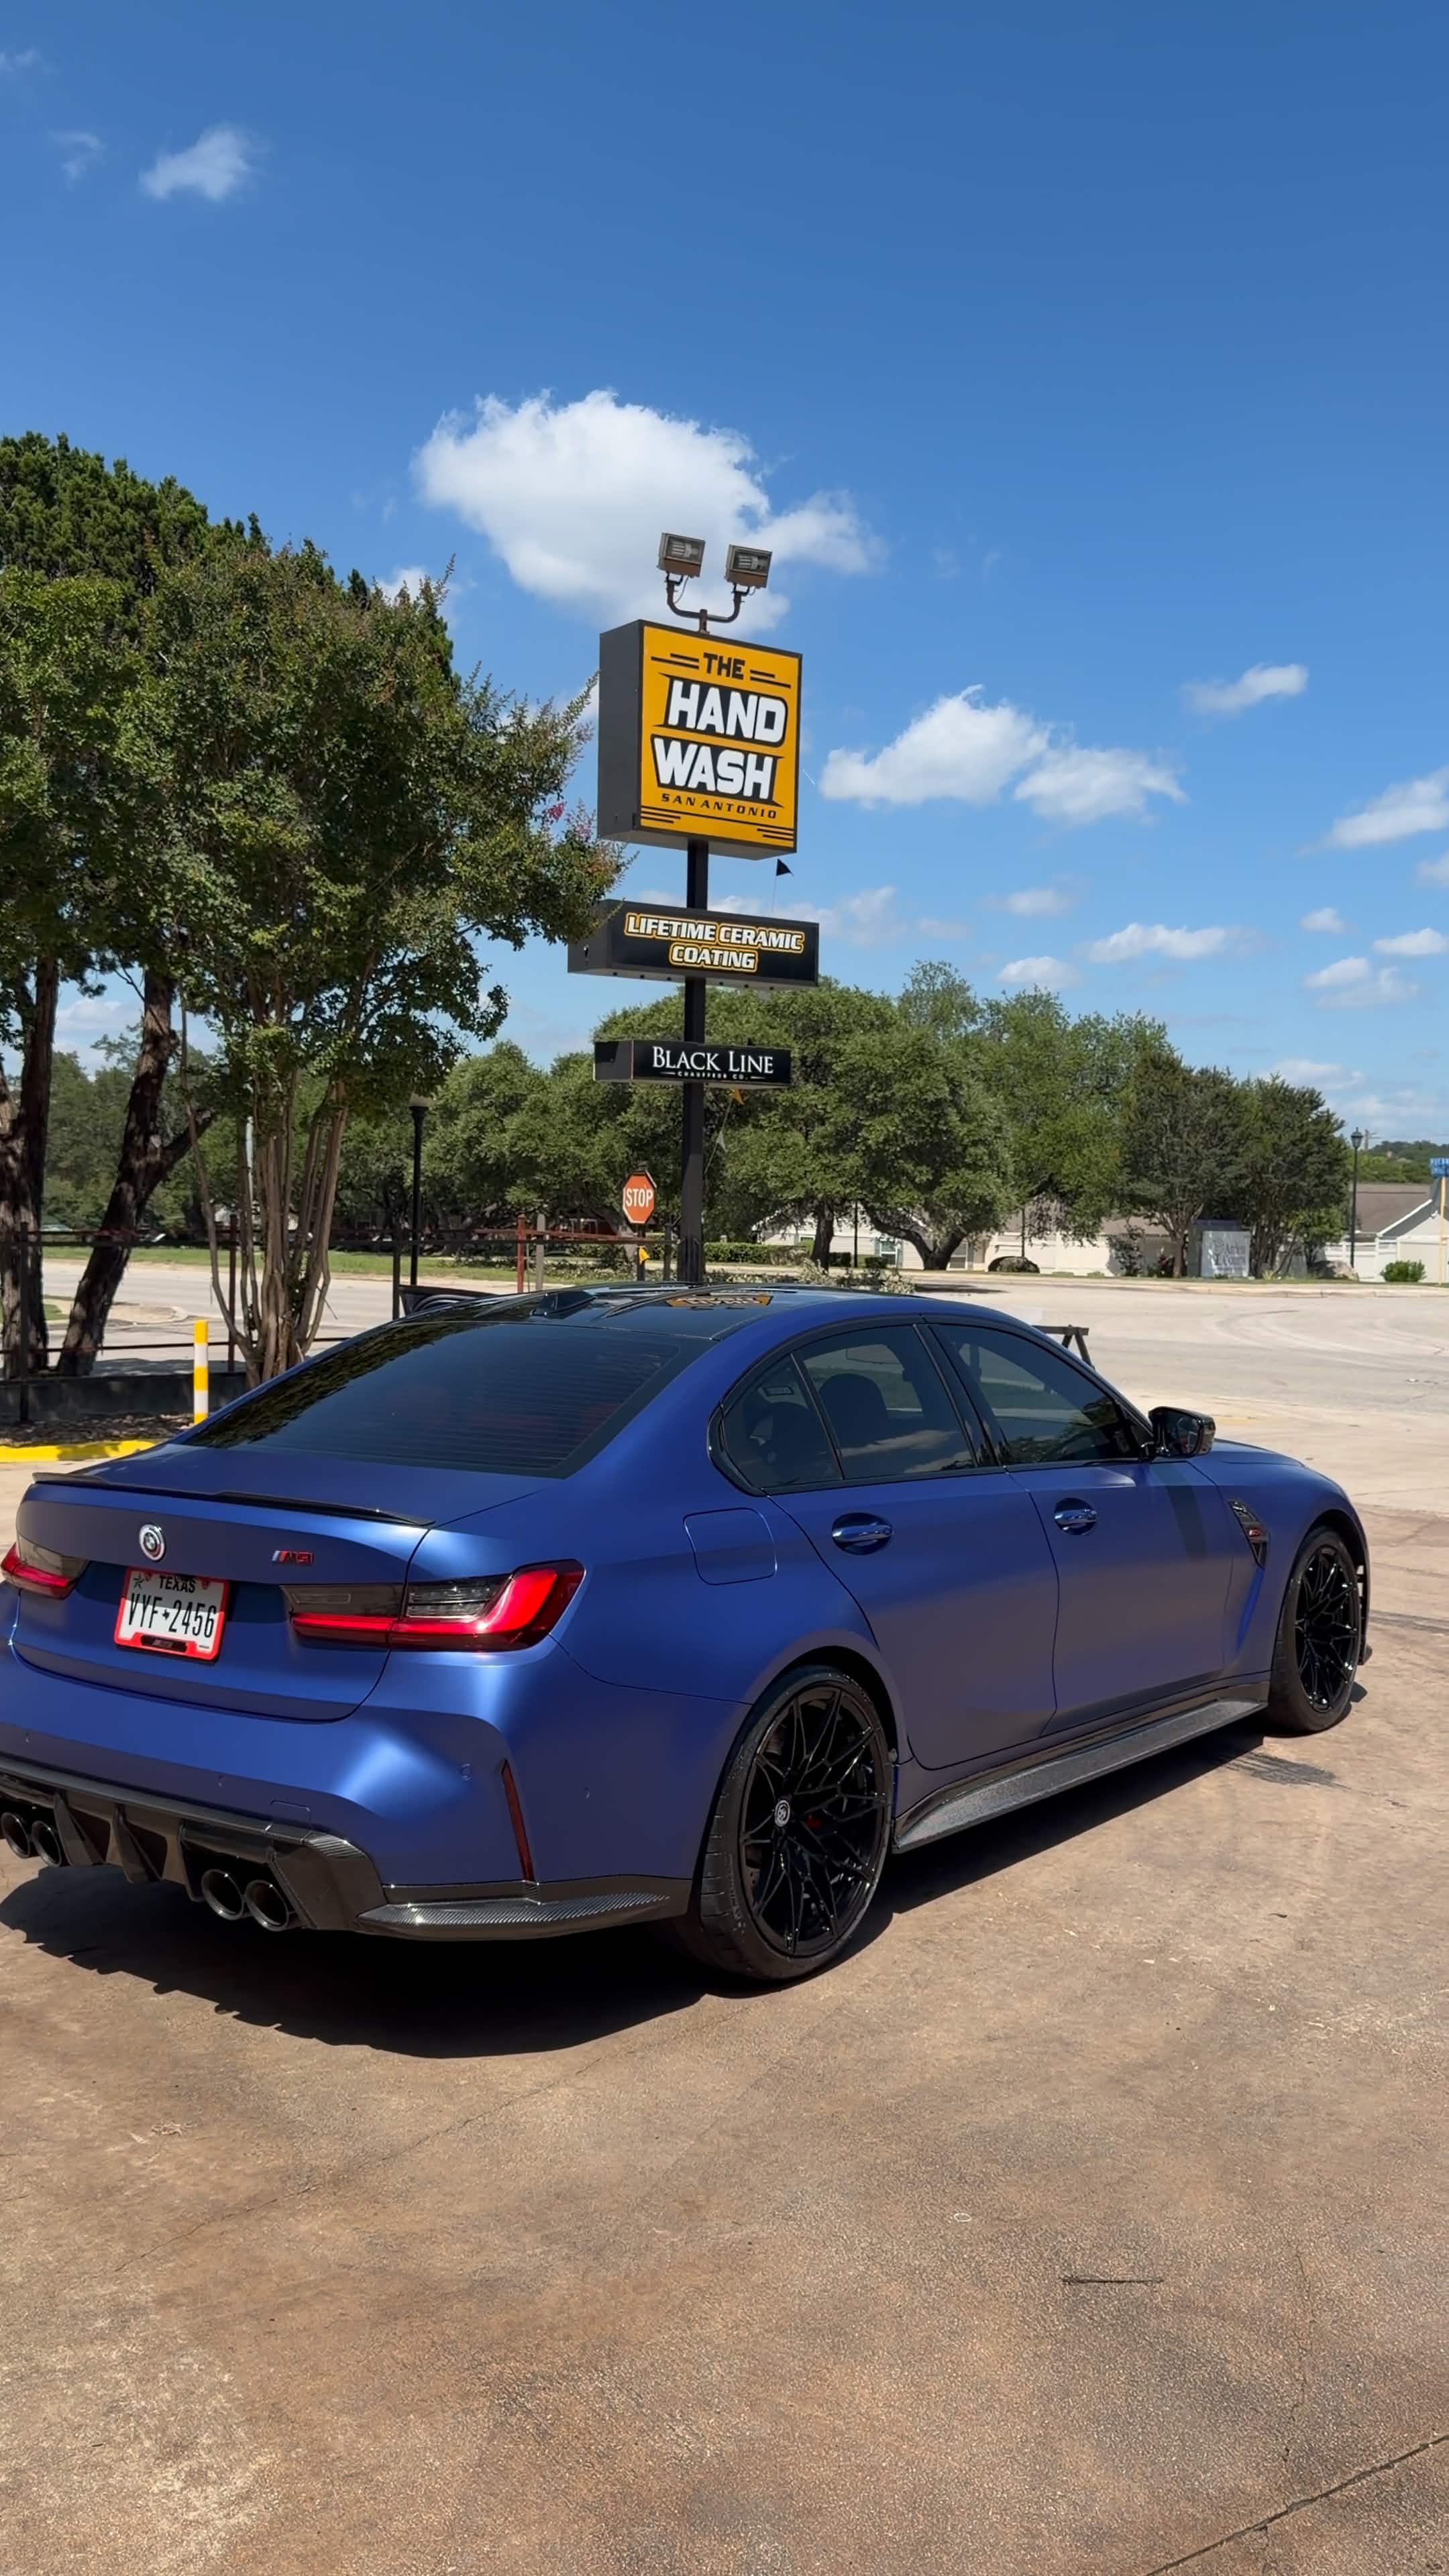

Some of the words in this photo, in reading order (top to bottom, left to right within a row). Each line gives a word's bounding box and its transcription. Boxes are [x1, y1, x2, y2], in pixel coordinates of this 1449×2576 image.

[703, 652, 746, 680] THE
[667, 680, 787, 744] HAND
[654, 737, 773, 800] WASH
[661, 793, 696, 806] SAN
[700, 800, 777, 819] ANTONIO
[626, 914, 717, 943] LIFETIME
[719, 925, 804, 951] CERAMIC
[671, 945, 756, 969] COATING
[652, 1045, 721, 1071] BLACK
[728, 1051, 774, 1074] LINE
[626, 1187, 654, 1208] STOP
[158, 1574, 196, 1594] TEXAS
